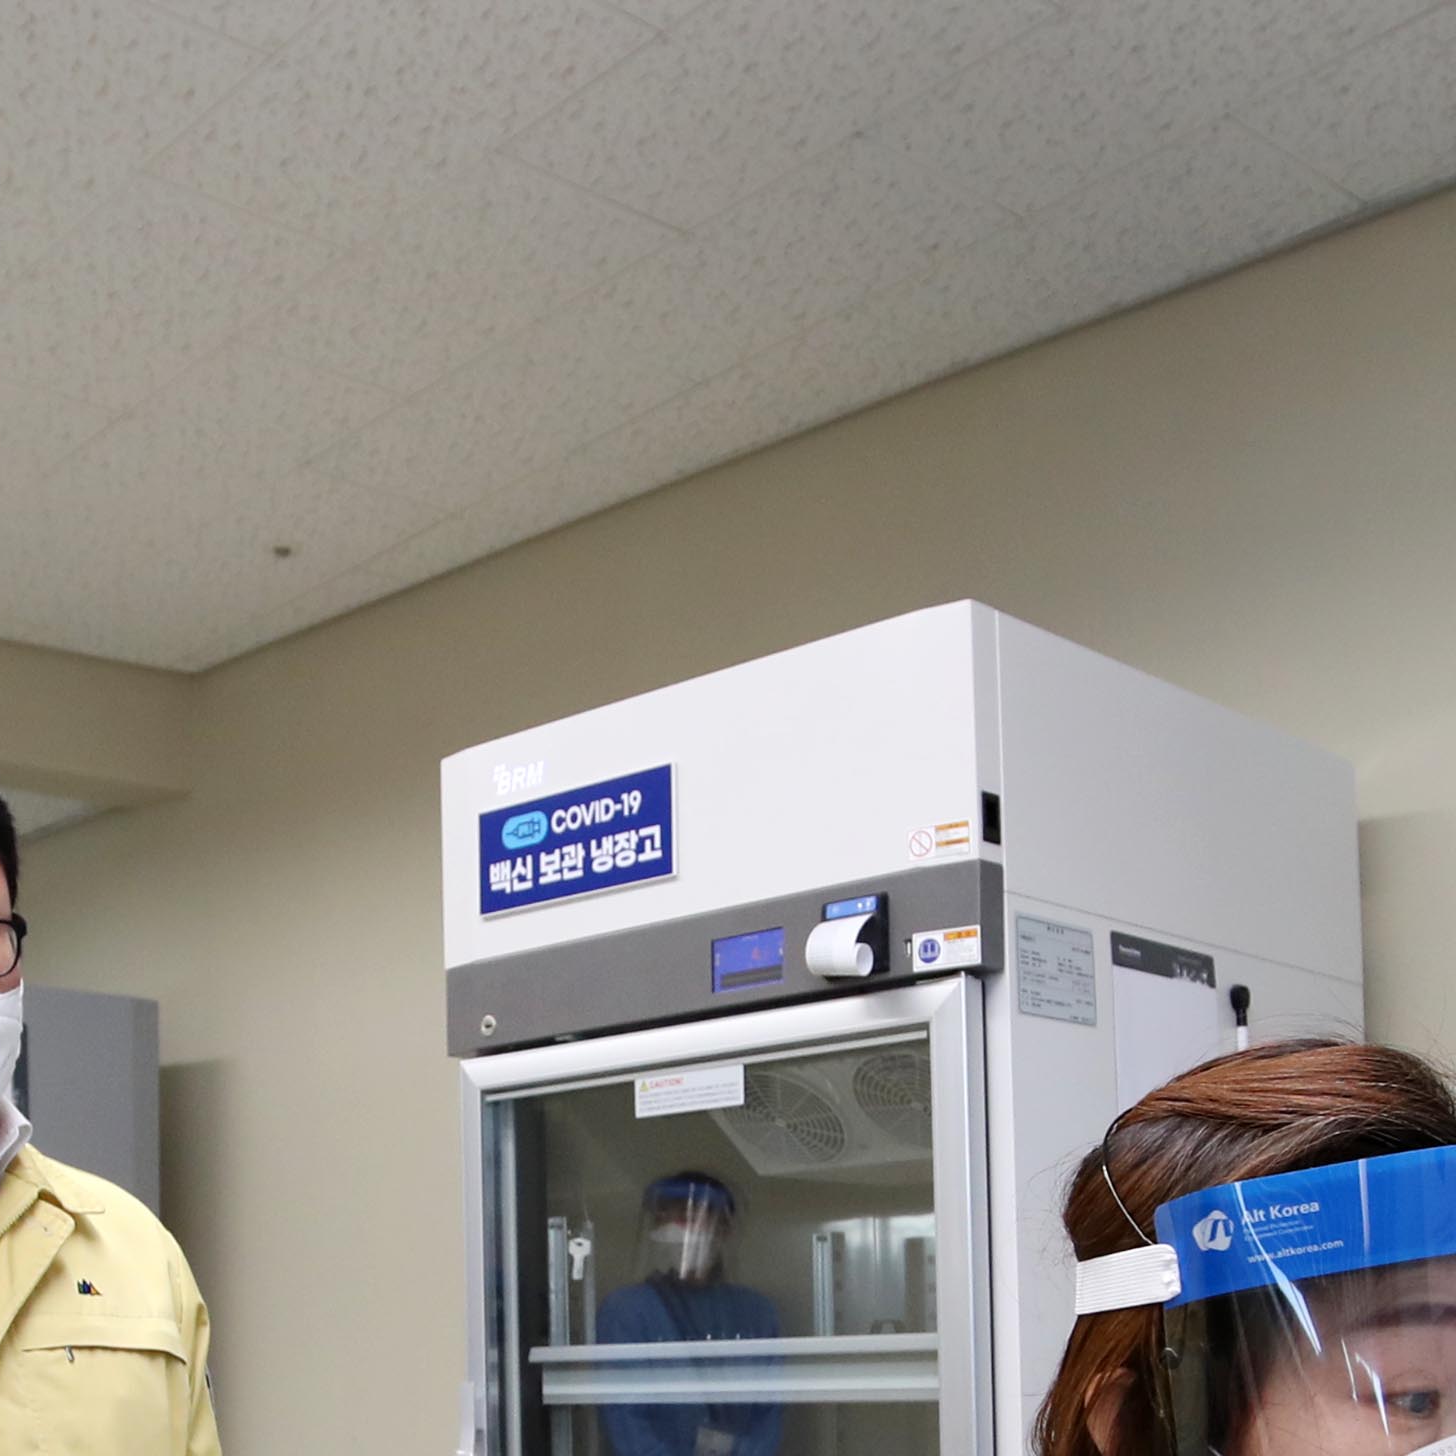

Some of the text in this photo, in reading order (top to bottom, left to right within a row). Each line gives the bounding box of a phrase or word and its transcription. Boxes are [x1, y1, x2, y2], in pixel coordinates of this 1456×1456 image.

[550, 790, 642, 834] COVID-19
[489, 824, 663, 894] 백신 보관 냉장고
[1269, 1201, 1320, 1220] Korea
